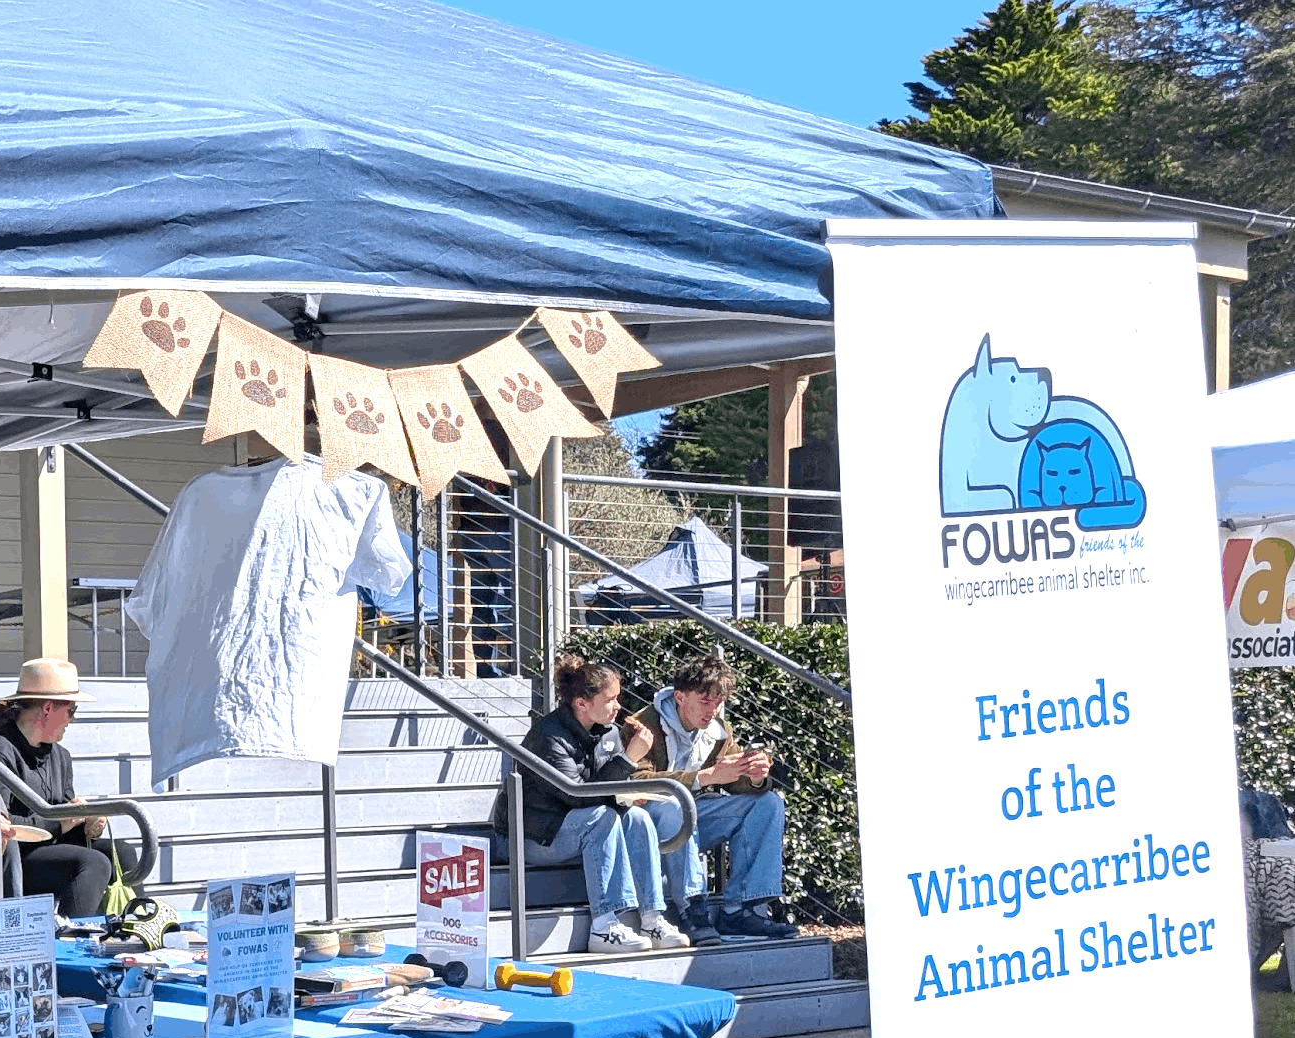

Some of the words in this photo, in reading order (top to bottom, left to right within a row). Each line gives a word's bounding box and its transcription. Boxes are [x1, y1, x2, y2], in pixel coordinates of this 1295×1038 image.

[941, 516, 1075, 568] FOWAS
[1079, 534, 1115, 559] friends
[1118, 533, 1127, 555] of
[1130, 531, 1145, 549] the
[944, 571, 1034, 606] wingecarribee
[1038, 566, 1079, 592] animal
[1083, 565, 1126, 589] shelter
[1129, 562, 1150, 584] inc.
[975, 678, 1130, 741] Friends
[1001, 767, 1043, 820] of
[1052, 763, 1115, 814] the
[425, 859, 480, 894] SALE
[907, 833, 1211, 918] Wingecarribee
[217, 926, 266, 942] VOLUNTEER
[267, 924, 289, 936] WITH
[424, 929, 478, 947] ACCESSORIES
[442, 917, 461, 929] DOG
[237, 943, 268, 956] FOWAS
[914, 928, 1070, 1002] Animal
[1079, 913, 1216, 972] Shelter
